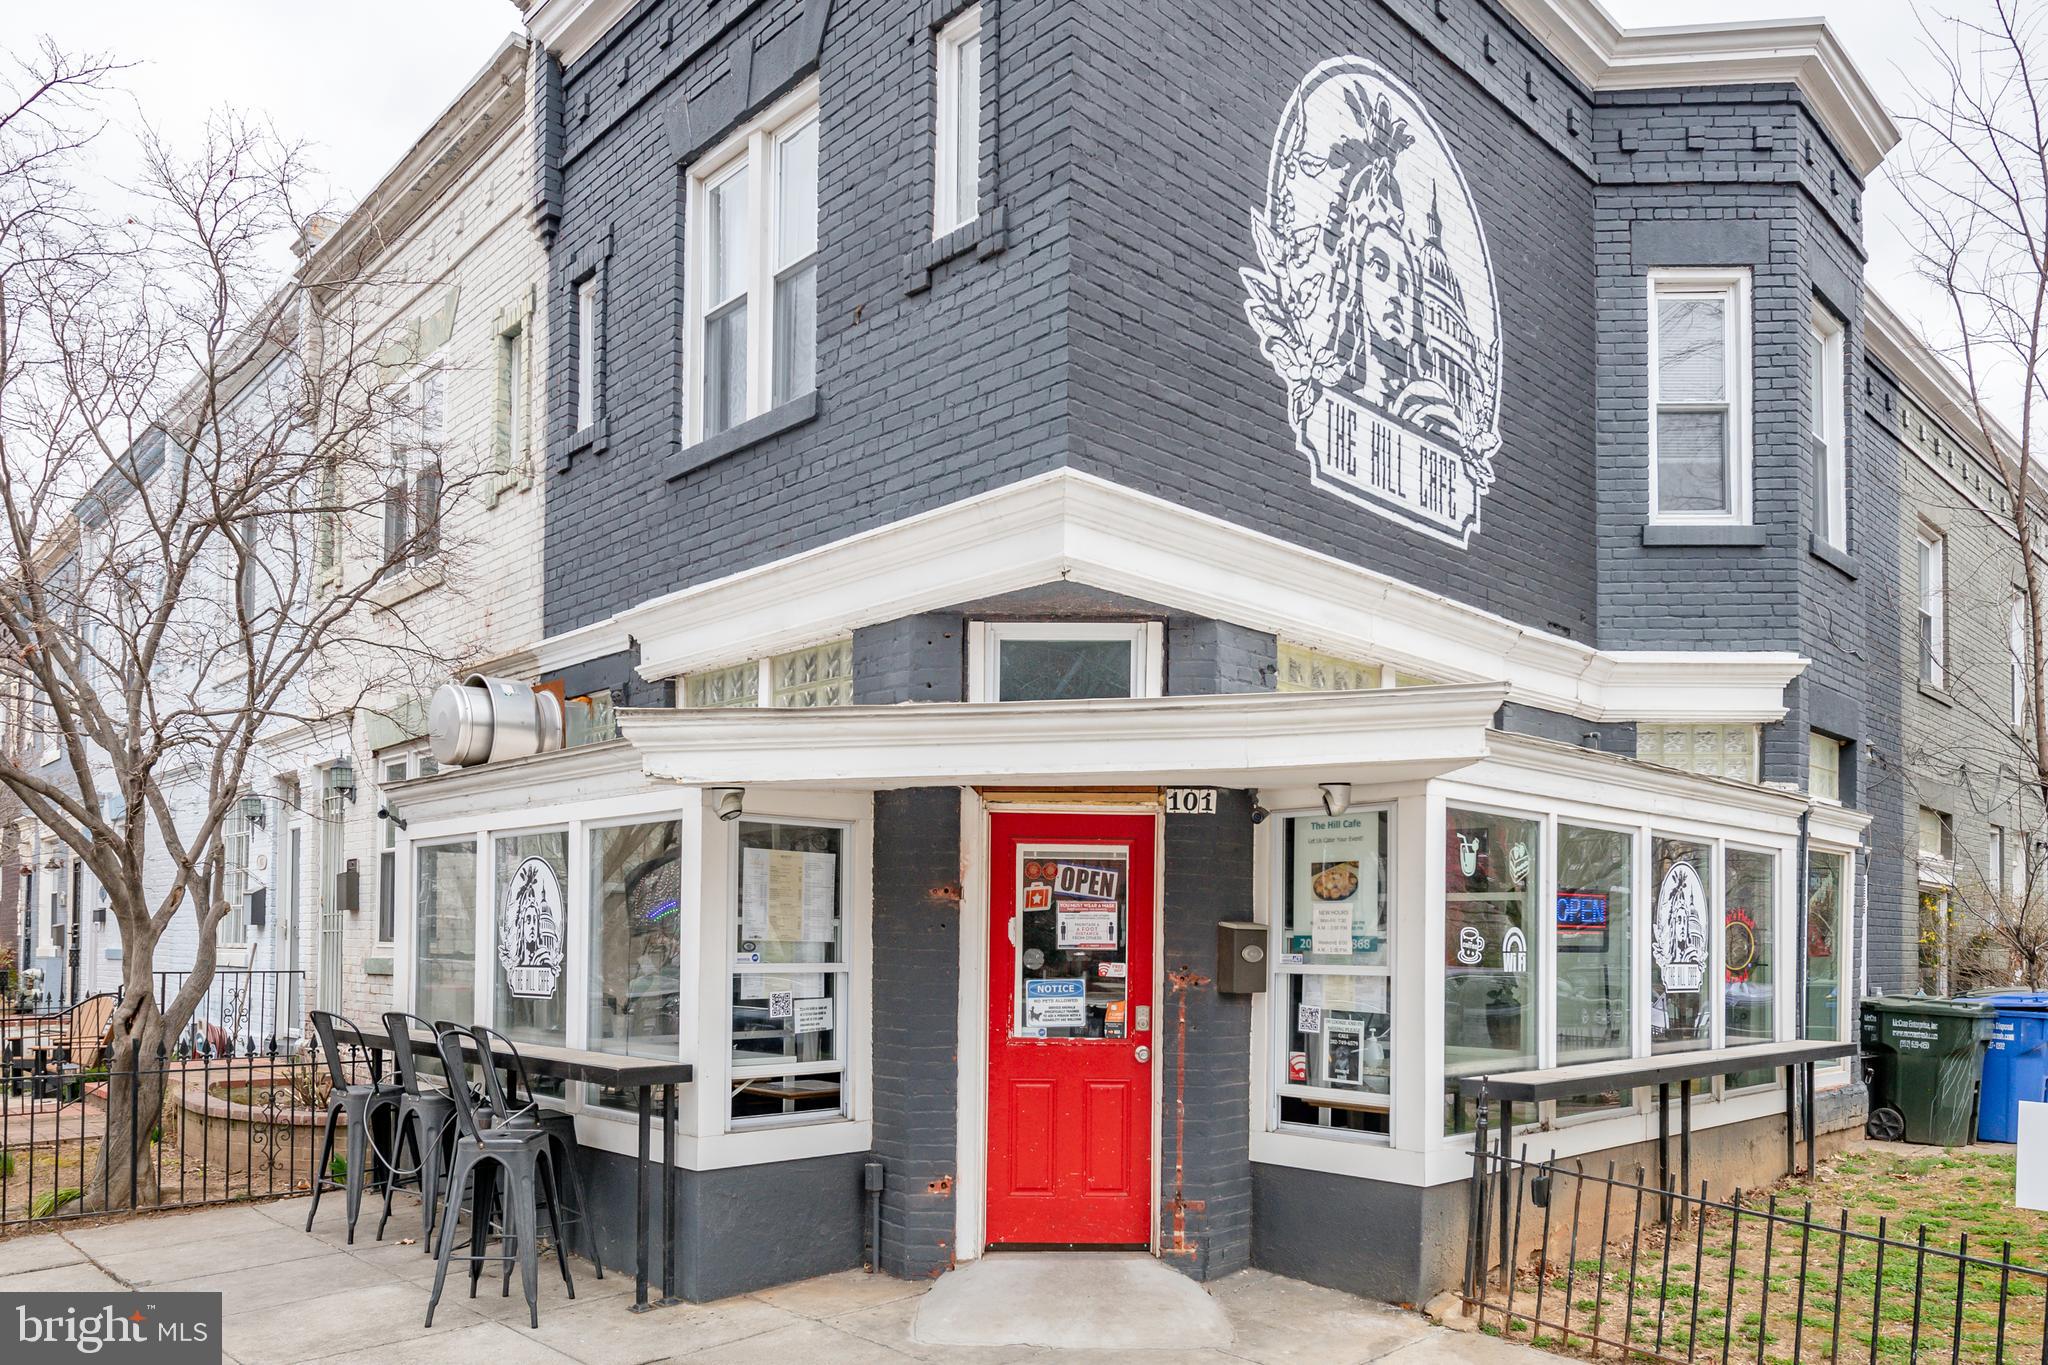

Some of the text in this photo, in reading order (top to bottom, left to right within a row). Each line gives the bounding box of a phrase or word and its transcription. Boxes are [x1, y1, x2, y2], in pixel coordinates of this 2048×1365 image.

[1325, 398, 1457, 520] THE HILL CAFE
[1168, 792, 1213, 811] 101
[1311, 819, 1361, 830] The Hill Cafe
[1061, 867, 1115, 898] OPEN
[1557, 898, 1605, 923] OPEN
[1037, 984, 1075, 993] NOTICE
